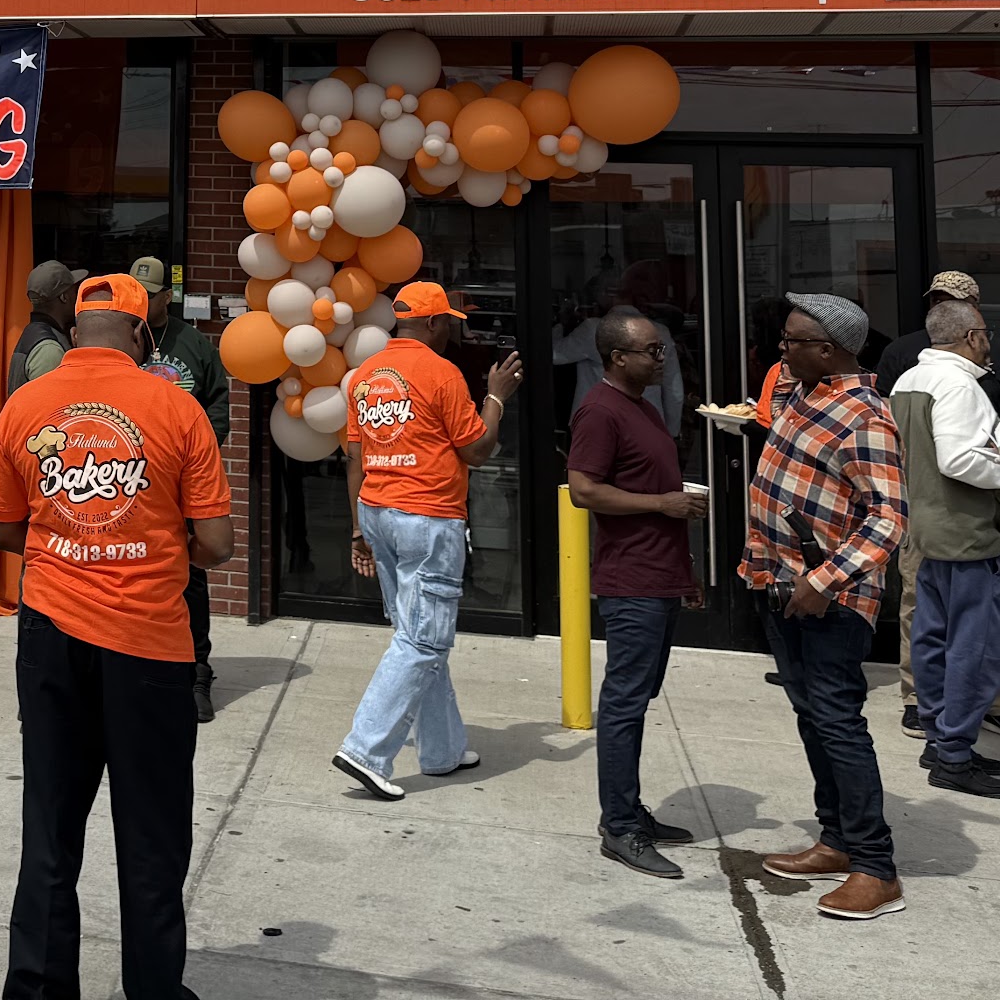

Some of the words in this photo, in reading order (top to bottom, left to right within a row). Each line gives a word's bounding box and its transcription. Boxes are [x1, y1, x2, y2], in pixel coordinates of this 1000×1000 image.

[357, 396, 416, 429] Bakery
[39, 451, 150, 503] Bakery
[92, 511, 109, 523] 2022
[113, 509, 135, 529] TASTY
[46, 531, 148, 562] 718-313-9733
